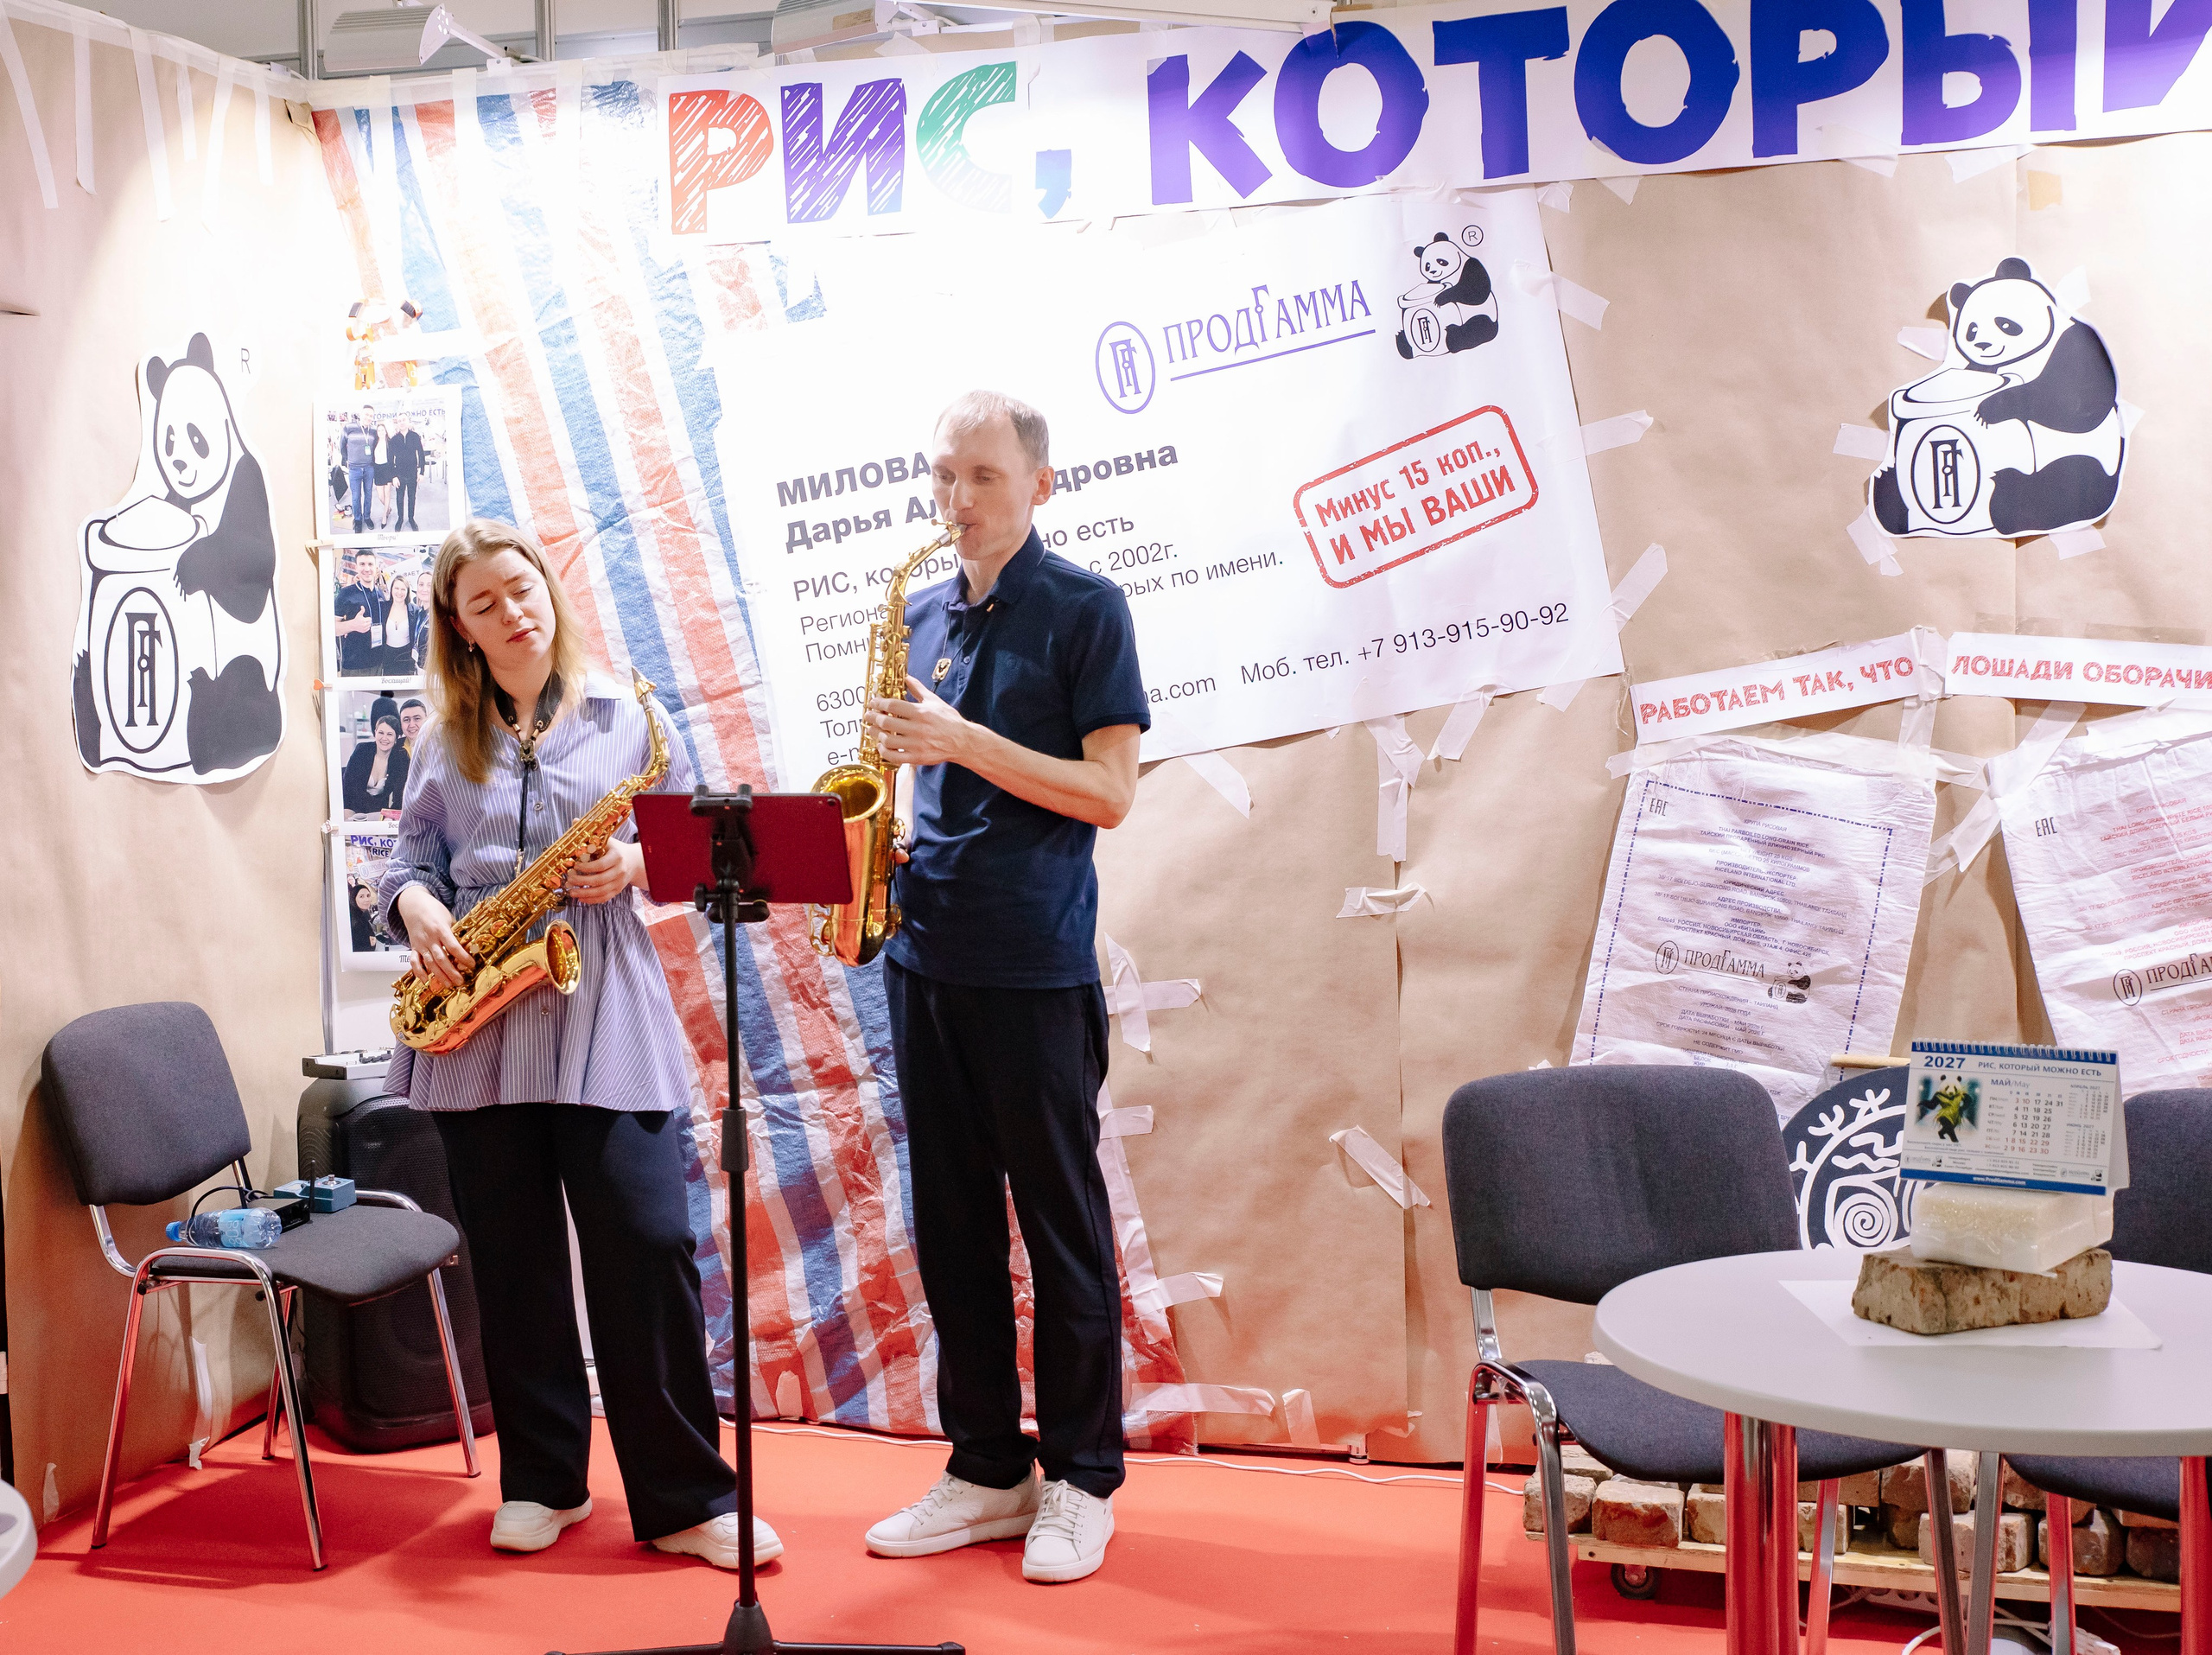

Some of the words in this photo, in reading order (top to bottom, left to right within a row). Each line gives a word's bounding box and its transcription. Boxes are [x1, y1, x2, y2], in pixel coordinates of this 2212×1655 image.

[669, 60, 1071, 234] РИС,
[1399, 459, 1430, 490] 15
[785, 509, 893, 554] Дарья
[1329, 533, 1356, 565] И
[1359, 506, 1416, 552] МЫ
[1421, 464, 1516, 526] ВАШИ
[793, 571, 857, 602] РИС,
[1077, 517, 1135, 541] есть
[1090, 561, 1102, 575] с
[1109, 543, 1177, 571] 2002г.
[1171, 570, 1198, 588] по
[1206, 551, 1282, 580] имени.
[1240, 656, 1297, 684] Моб.
[1303, 648, 1350, 672] тел.
[1357, 639, 1385, 660] +7
[1393, 602, 1569, 655] 913-915-90-92
[1640, 679, 1786, 725] РАБОТАЕМ
[1792, 671, 1854, 697] ТАК,
[1859, 657, 1913, 684] ЧТО
[1951, 655, 2074, 681] ЛОШАДИ
[350, 835, 377, 846] РИС,
[1923, 1055, 1966, 1069] 2027
[1999, 1062, 2040, 1072] КОТОРЫЙ
[2043, 1066, 2078, 1075] МОЖНО
